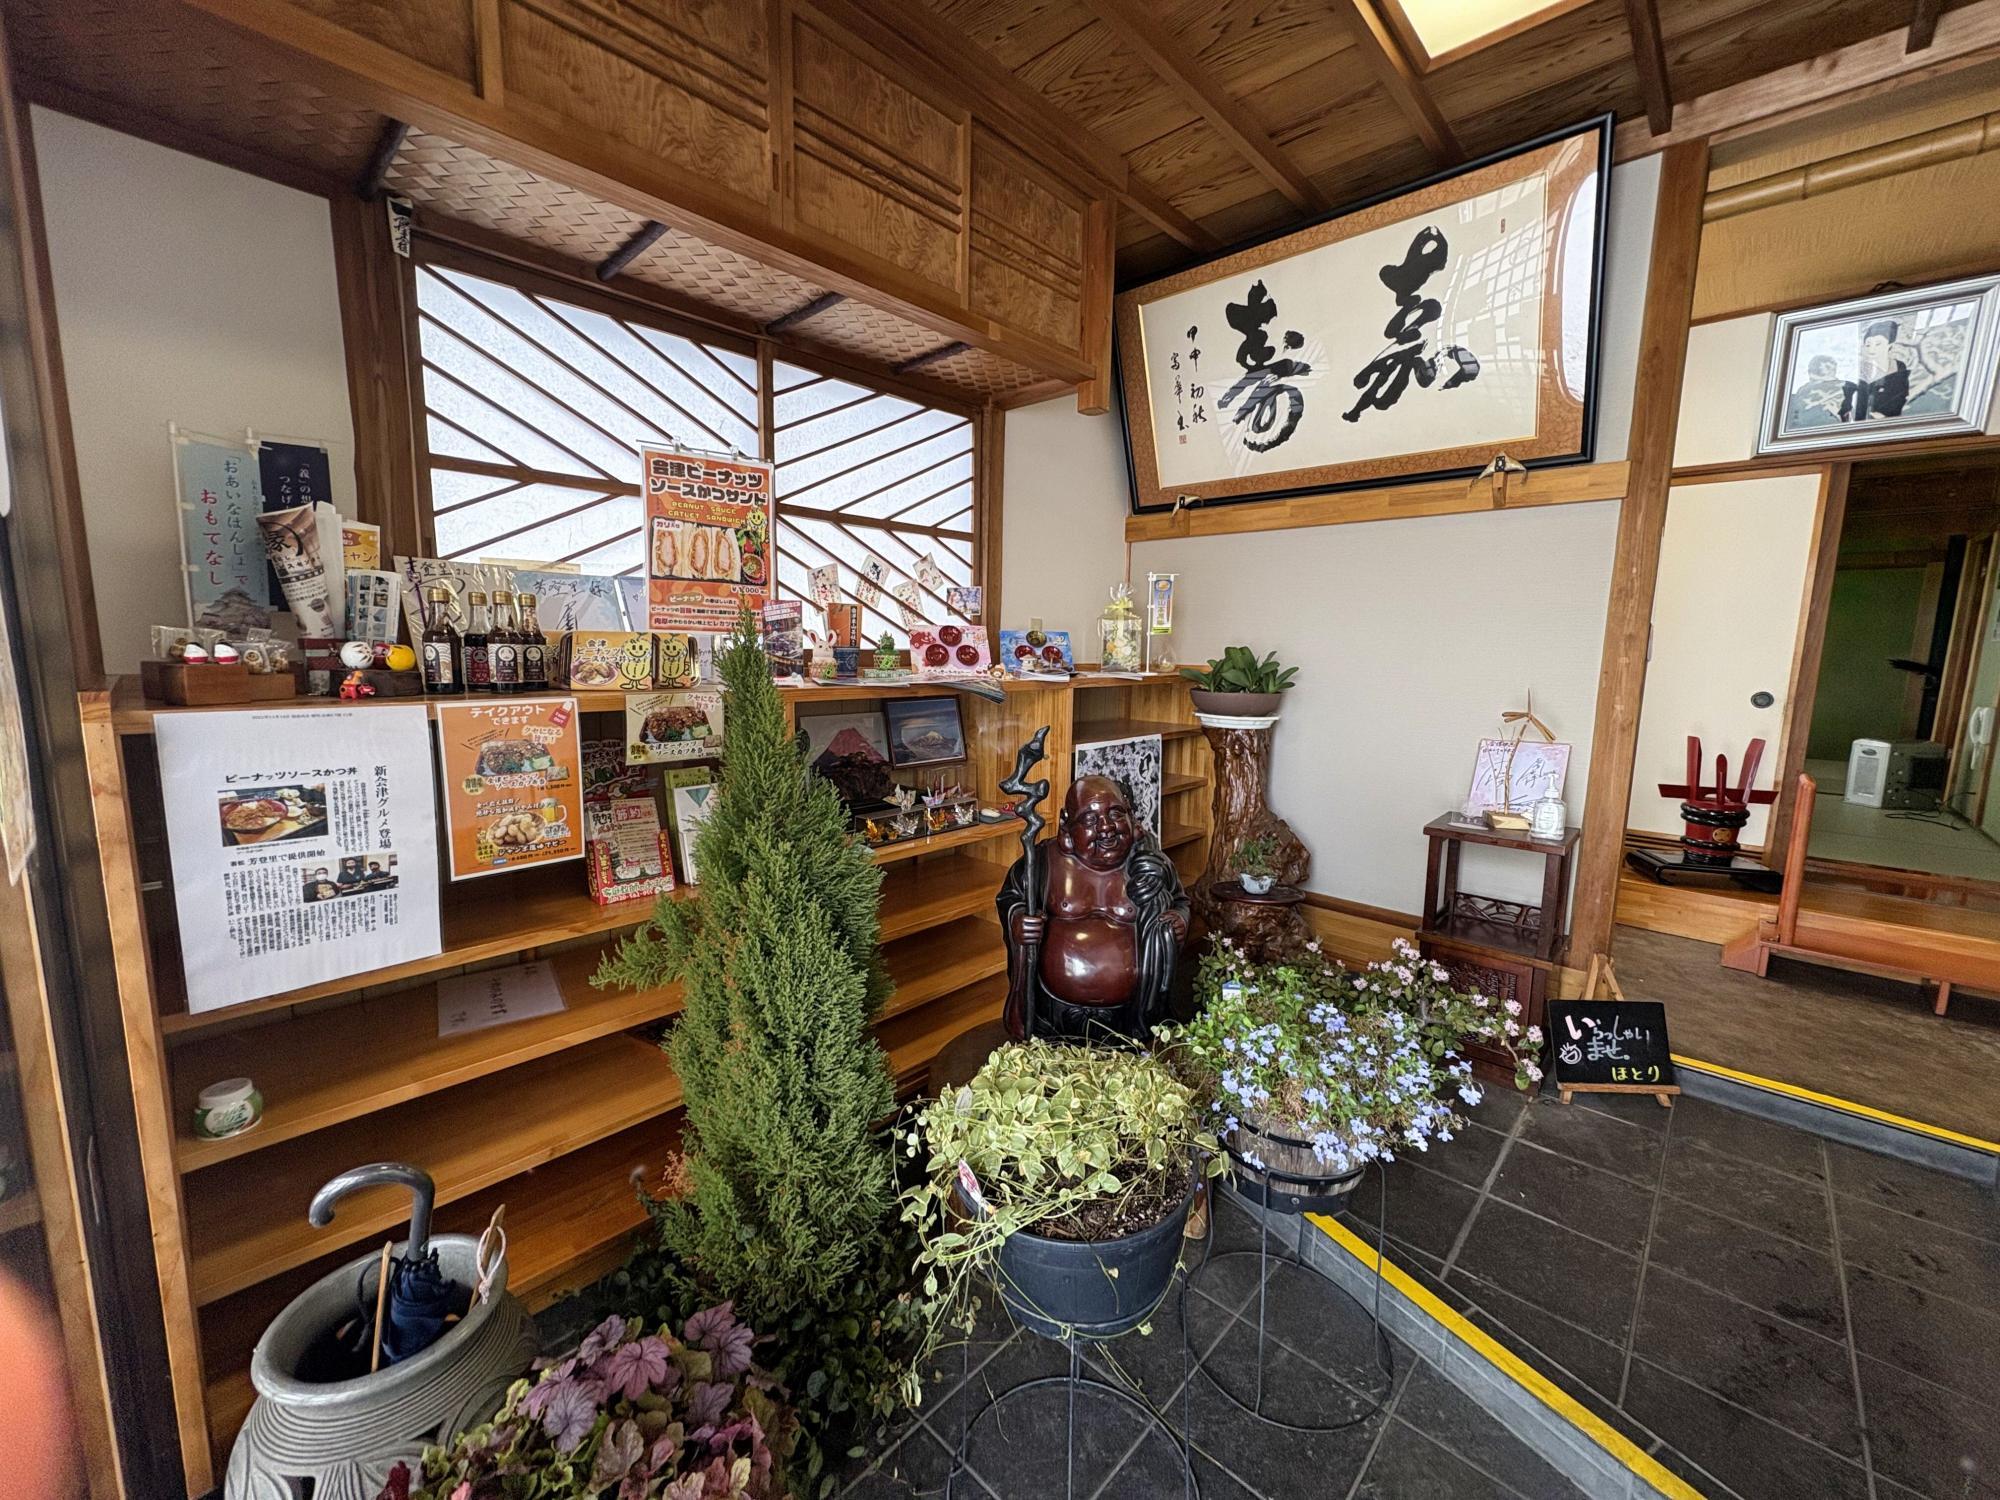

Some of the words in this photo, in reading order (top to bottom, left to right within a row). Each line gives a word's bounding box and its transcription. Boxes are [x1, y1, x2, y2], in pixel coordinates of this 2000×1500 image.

[279, 474, 293, 509] つなげ
[650, 478, 768, 506] ソースかつサンド
[200, 488, 225, 586] おもてなし
[470, 704, 546, 719] テイクアウト
[491, 715, 529, 726] できます
[524, 726, 563, 737] クセになる
[225, 767, 358, 784] ピーナッツソースかつ丼
[374, 764, 392, 850] 新会津グルメ登場
[615, 805, 641, 821] 節約
[249, 849, 326, 866] 芳登里で提供開始
[1564, 1015, 1650, 1043] いらっしゃい
[1586, 1038, 1631, 1061] ませ。
[1611, 1065, 1660, 1082] ほとり
